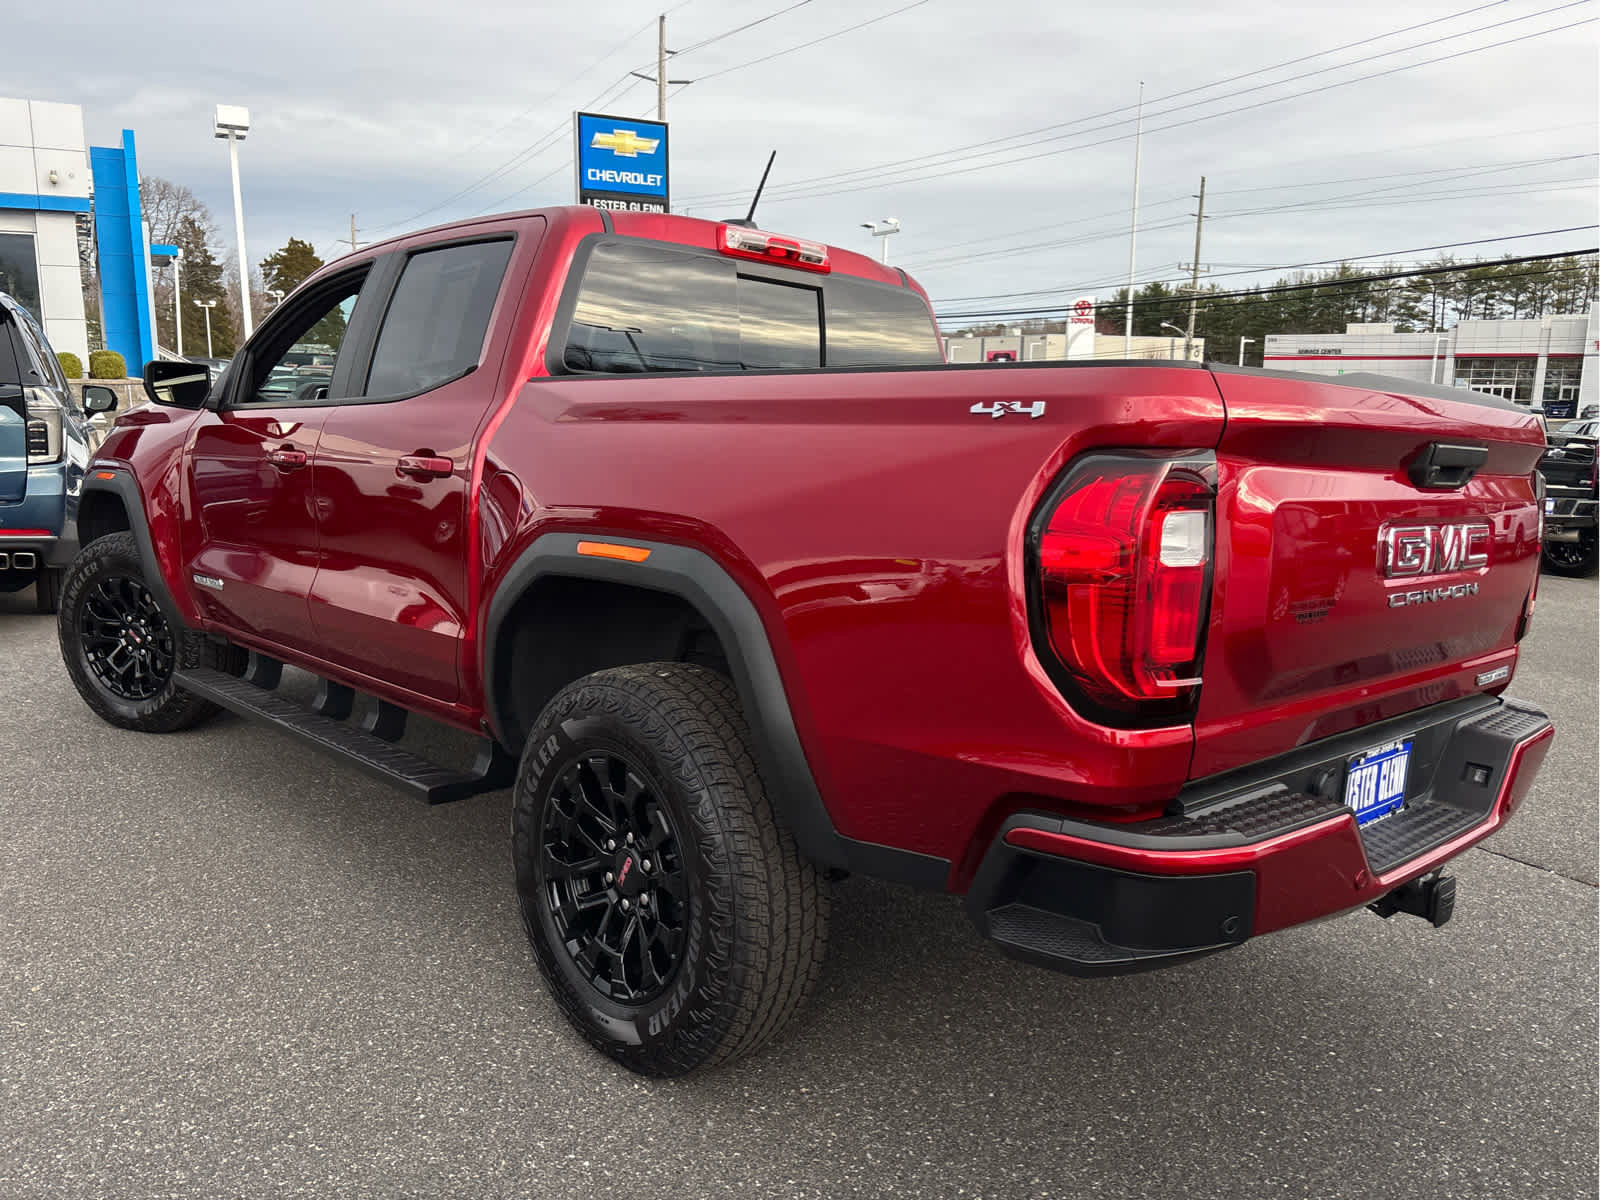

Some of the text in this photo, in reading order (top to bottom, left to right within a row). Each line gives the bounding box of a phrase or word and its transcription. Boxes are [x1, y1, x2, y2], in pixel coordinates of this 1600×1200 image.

[588, 168, 662, 186] CHEVROLET
[587, 198, 664, 215] LESTER GLENN
[1386, 523, 1490, 578] GMC
[1387, 581, 1480, 609] CANYON
[1344, 753, 1408, 812] LESTER GLENN
